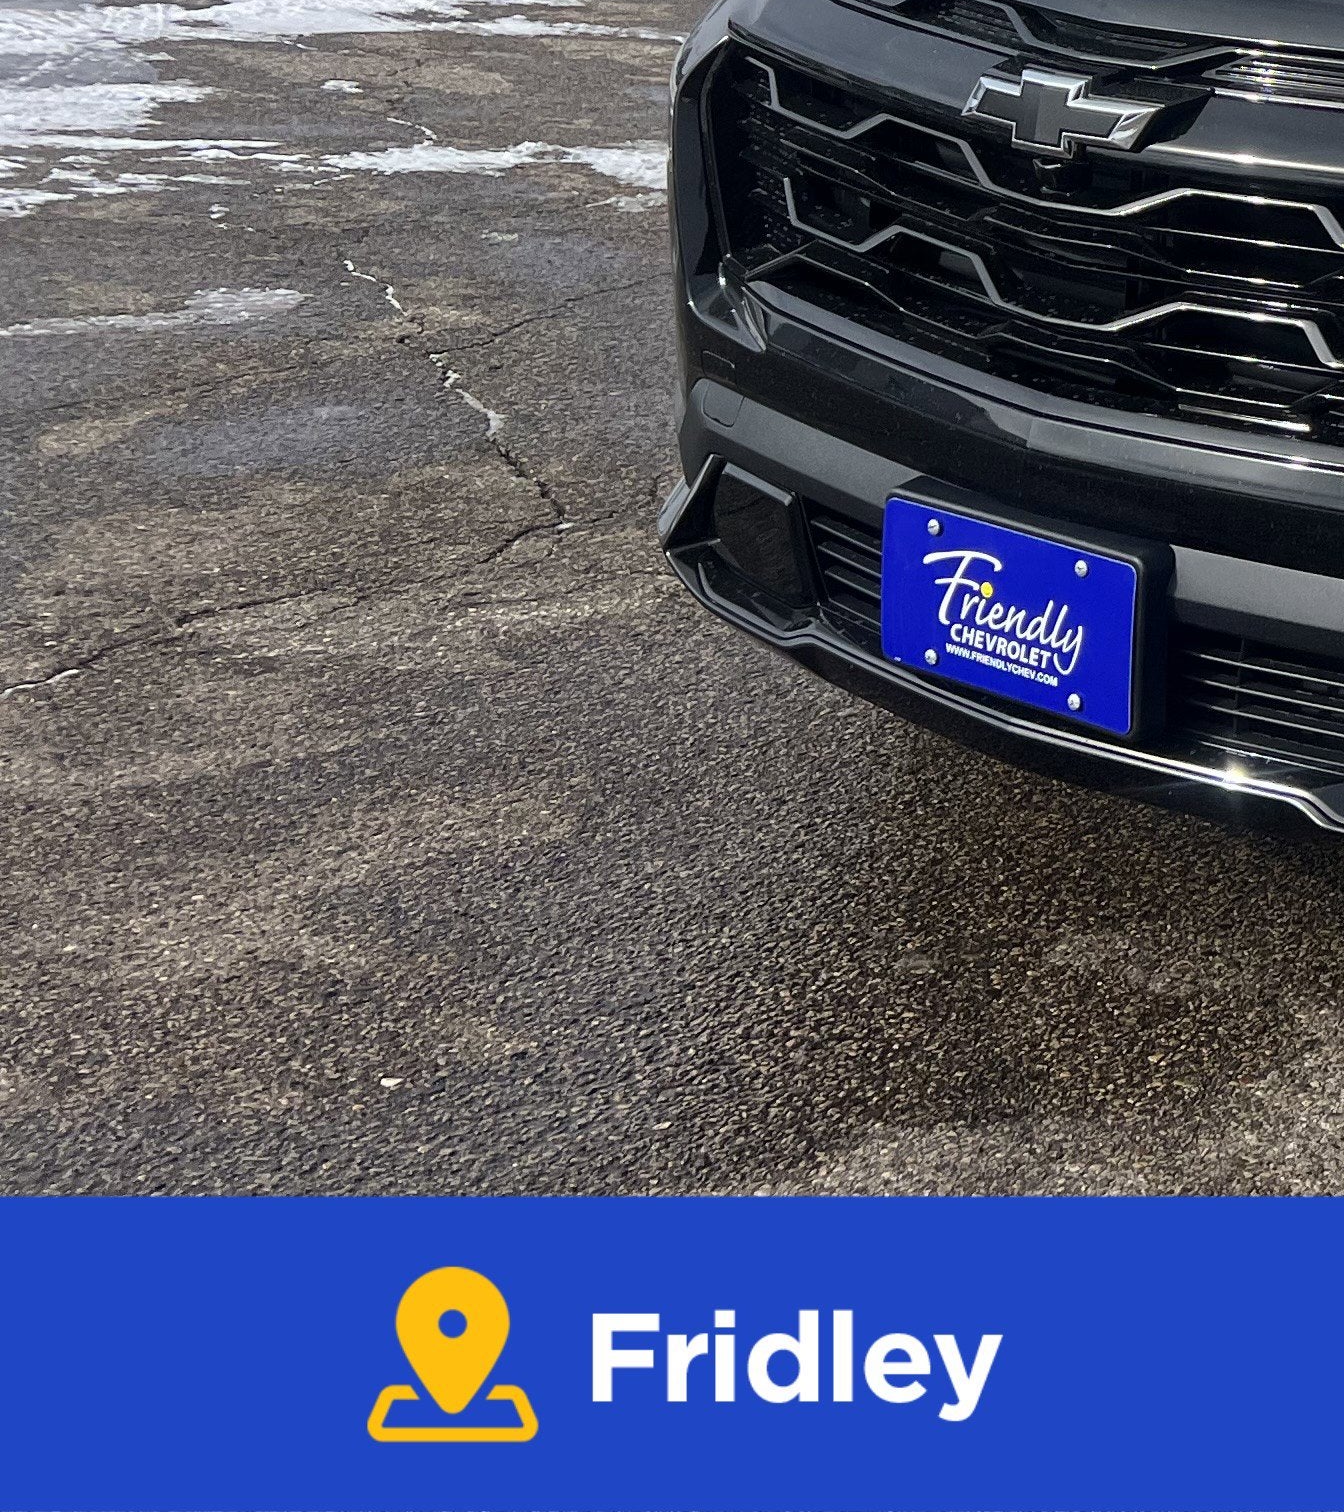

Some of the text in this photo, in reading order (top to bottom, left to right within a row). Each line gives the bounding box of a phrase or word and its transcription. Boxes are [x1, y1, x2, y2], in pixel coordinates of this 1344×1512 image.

[922, 550, 1083, 676] Friendly
[945, 642, 1059, 687] WWW.FRIENDLYCHEV.COM
[950, 623, 1052, 670] CHEVROLET
